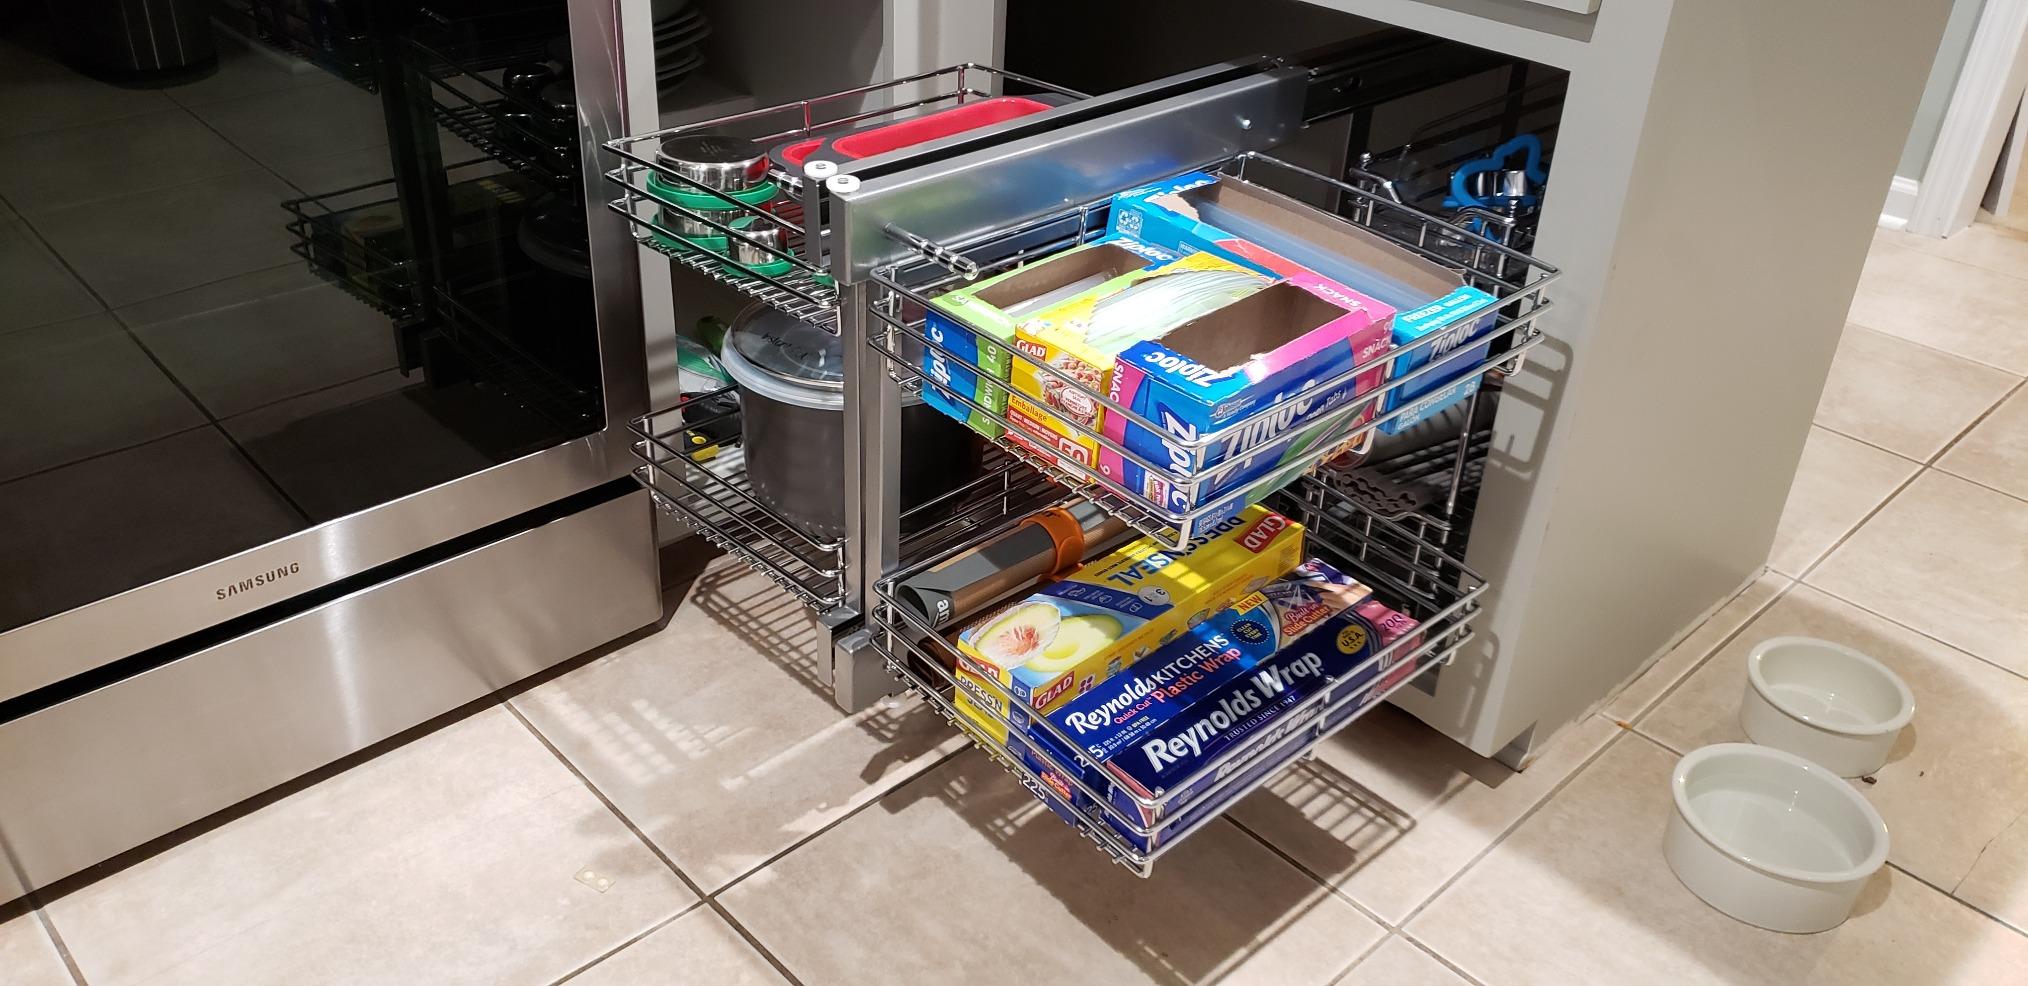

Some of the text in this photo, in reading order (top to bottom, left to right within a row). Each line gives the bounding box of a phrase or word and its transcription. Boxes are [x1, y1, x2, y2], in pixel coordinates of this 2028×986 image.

[1315, 283, 1363, 309] SNACK
[989, 345, 998, 364] 40
[1016, 339, 1046, 358] GLAD
[1144, 351, 1218, 388] Ziploc
[1011, 395, 1048, 422] Emballage
[1245, 515, 1287, 550] GLAD
[216, 562, 300, 600] SAMSUNG
[1107, 551, 1170, 586] SEAL
[1238, 595, 1262, 611] NEW
[1284, 605, 1331, 636] Slide Cutter
[1035, 673, 1074, 709] GLAD
[1065, 674, 1154, 735] Reynolds
[1150, 634, 1231, 686] KITCHENS
[1113, 647, 1242, 724] Quick Cut Plastic Wrap
[1141, 651, 1322, 774] Reynolds Wrap
[1224, 695, 1297, 741] TRUSTED SINCE 1947
[1073, 744, 1104, 768] 25
[1022, 773, 1046, 799] 225
